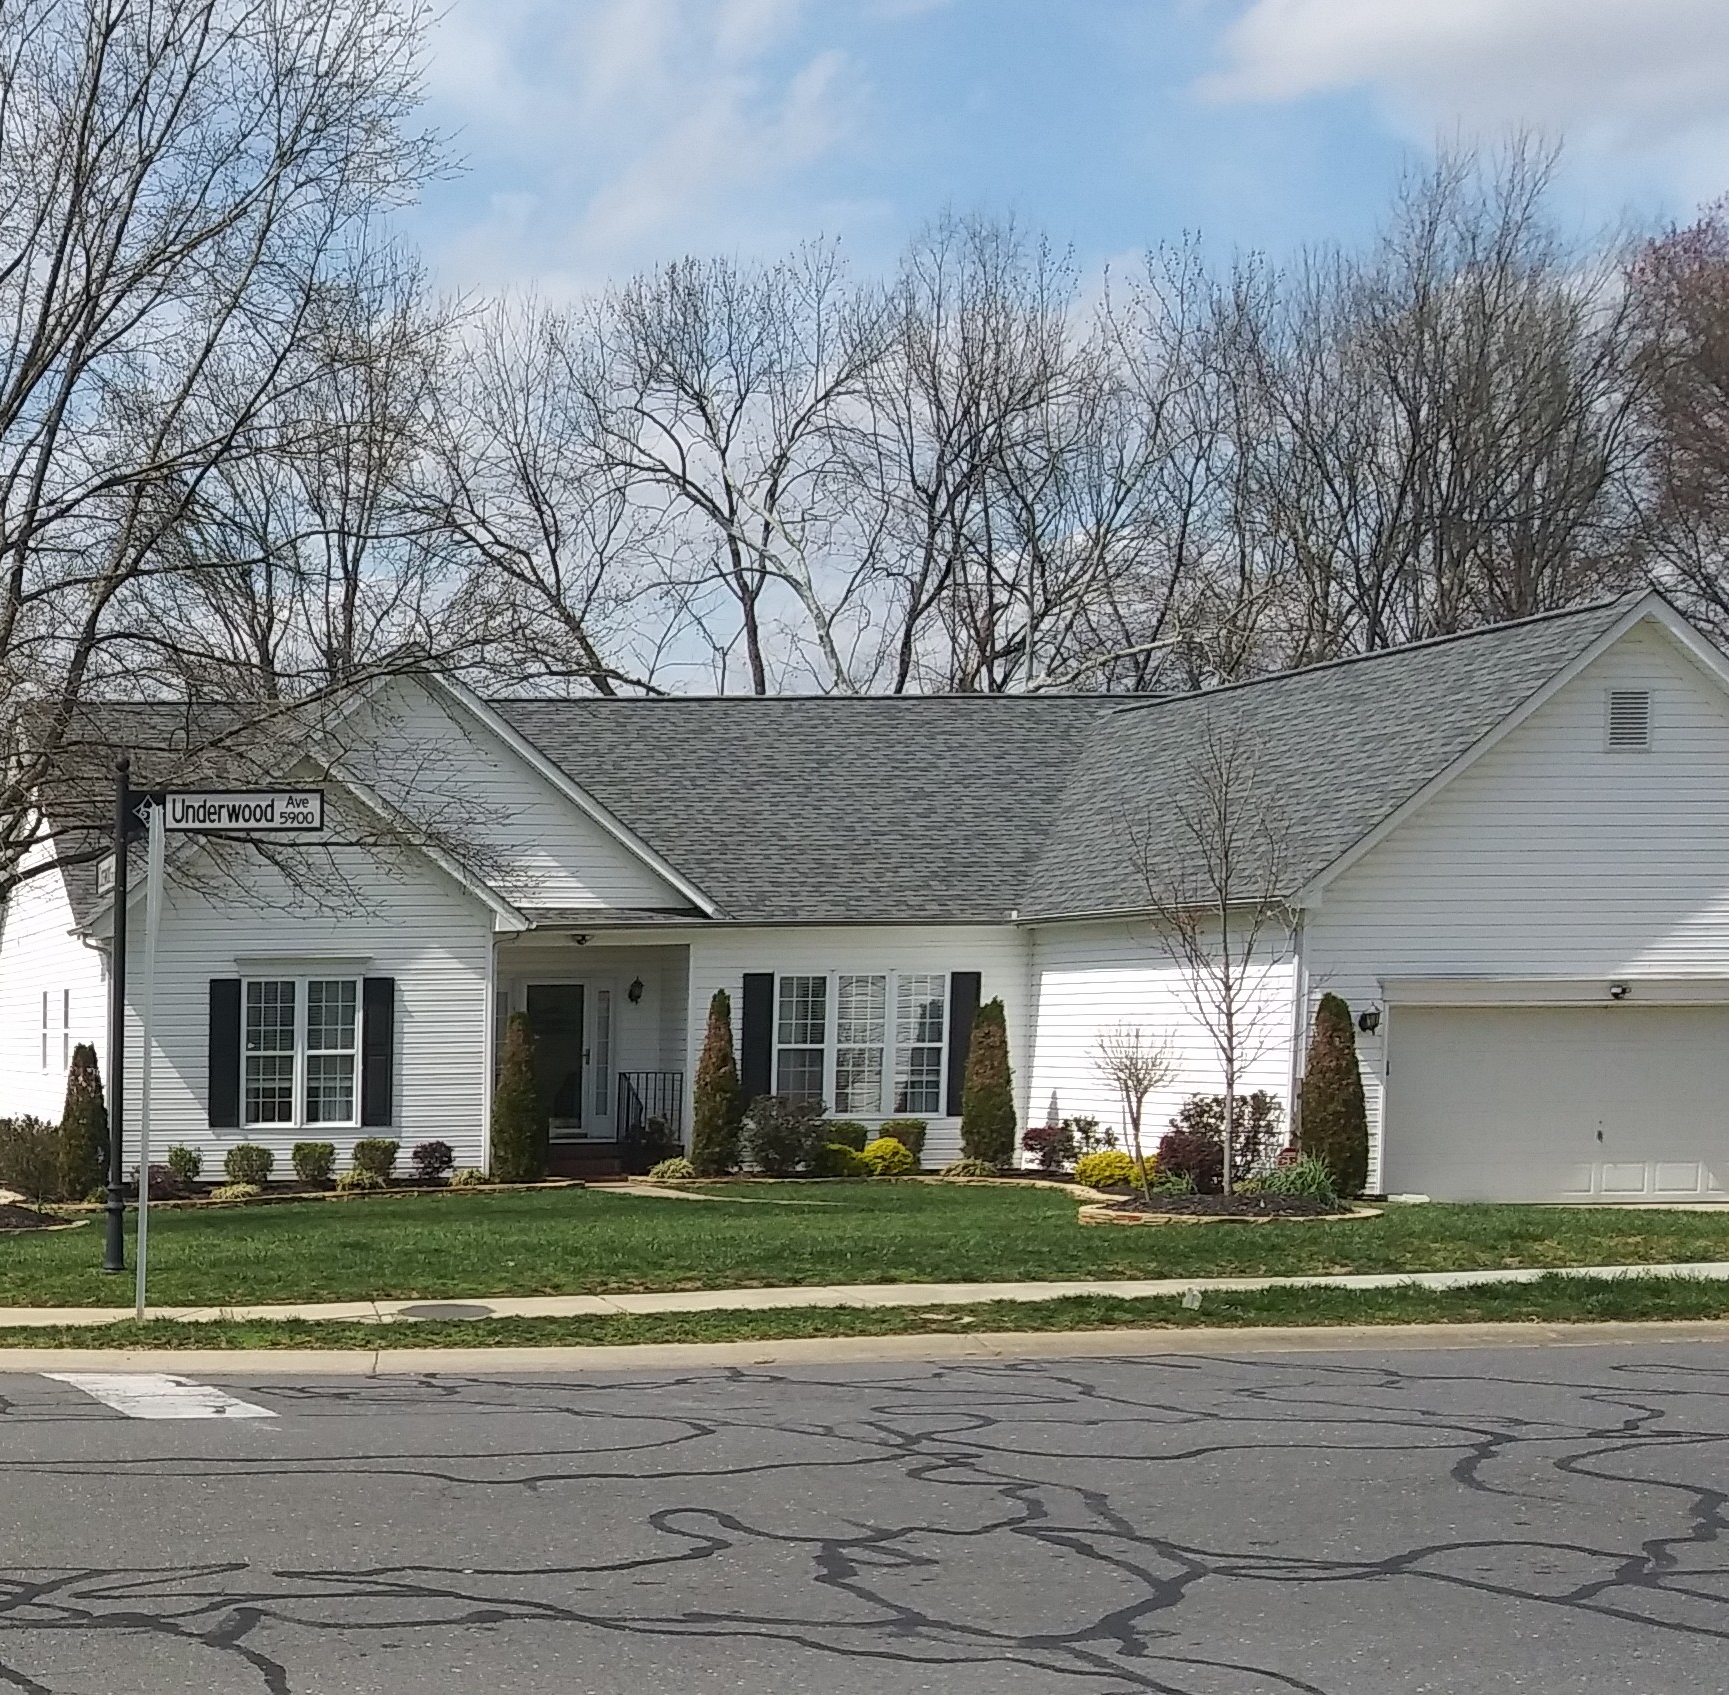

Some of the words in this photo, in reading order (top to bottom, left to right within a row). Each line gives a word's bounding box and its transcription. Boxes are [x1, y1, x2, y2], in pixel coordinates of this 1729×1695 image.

[172, 798, 275, 823] Underwood
[285, 795, 310, 809] Ave
[279, 811, 315, 825] 5900
